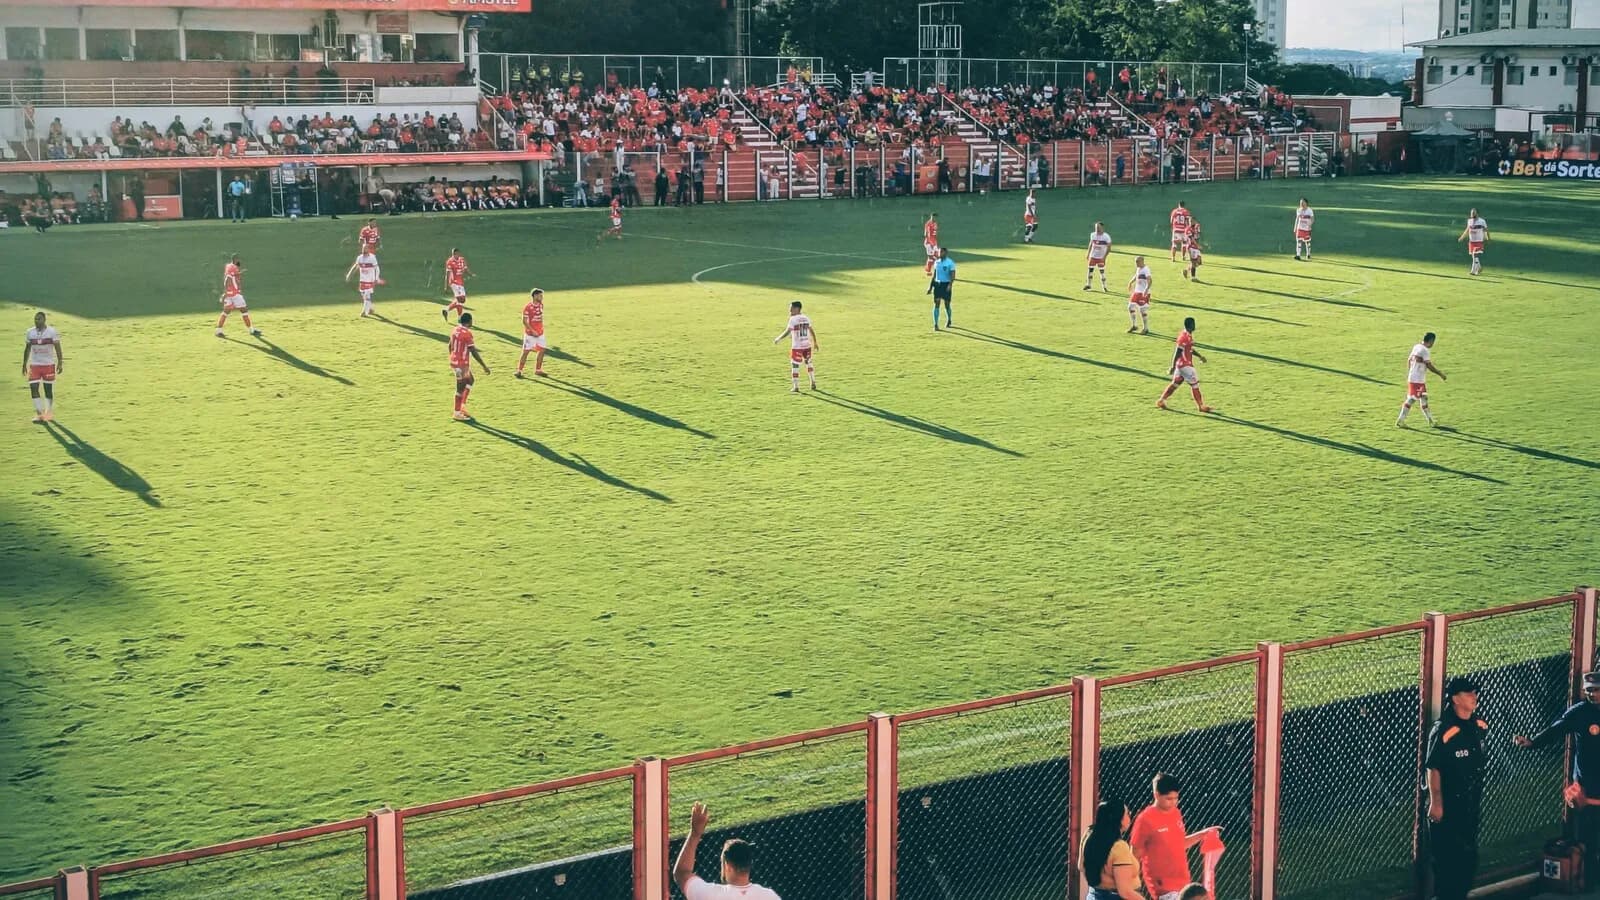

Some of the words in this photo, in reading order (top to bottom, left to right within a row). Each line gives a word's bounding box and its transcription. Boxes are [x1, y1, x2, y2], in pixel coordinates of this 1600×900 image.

[1513, 160, 1542, 176] Bet
[1544, 162, 1556, 172] dá
[1557, 161, 1600, 178] Sorte
[799, 323, 809, 336] 10
